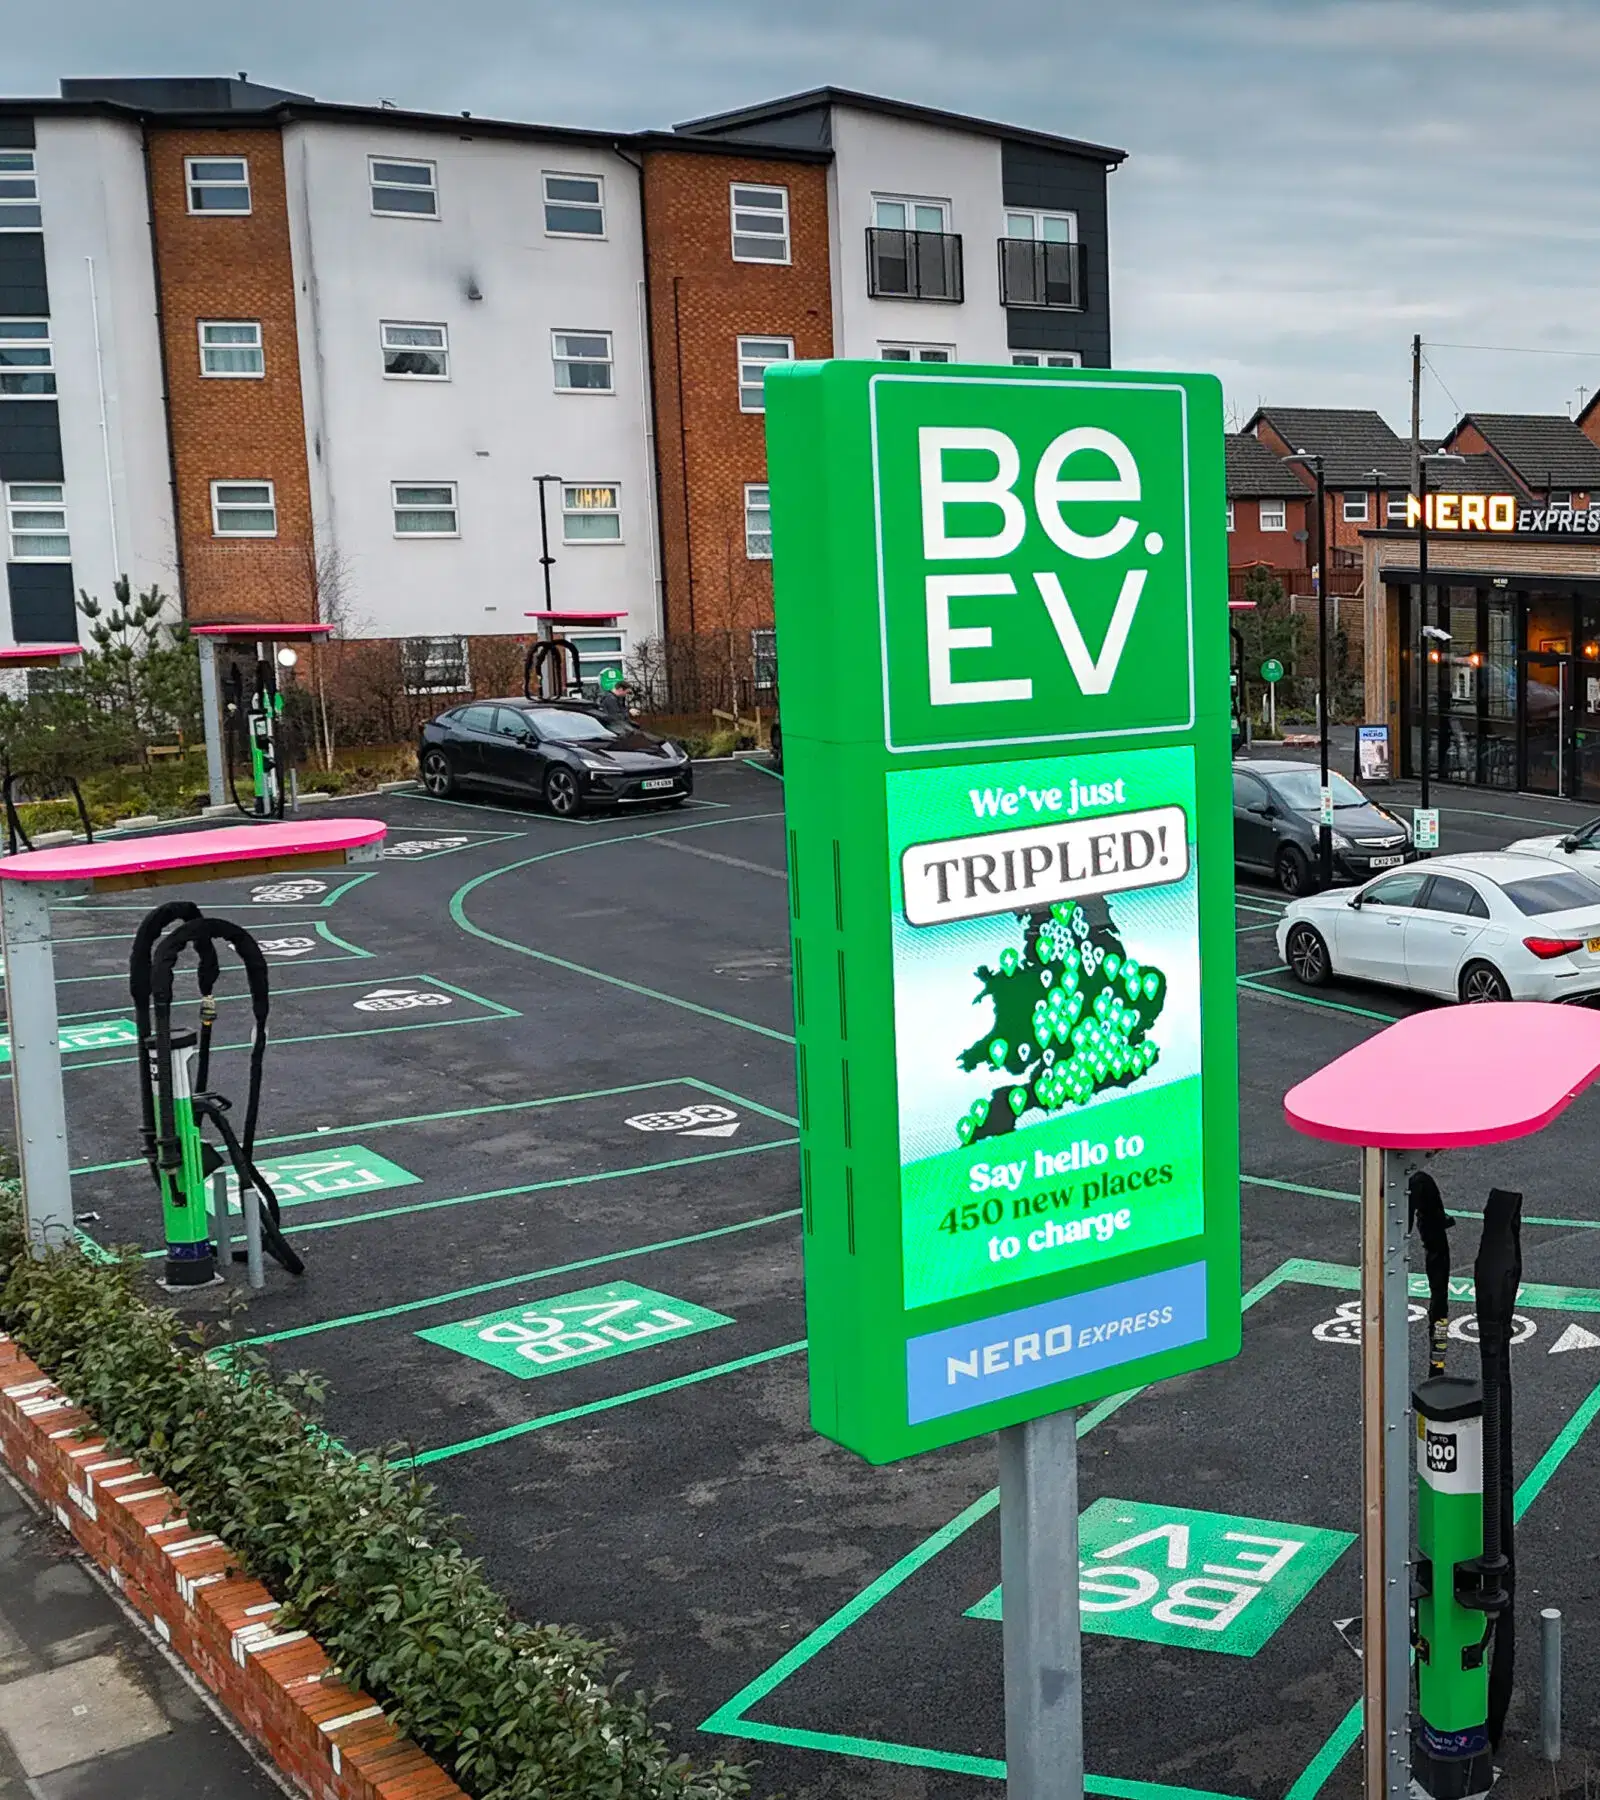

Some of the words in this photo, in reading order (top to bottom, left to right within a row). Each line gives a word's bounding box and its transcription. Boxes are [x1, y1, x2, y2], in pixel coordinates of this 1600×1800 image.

[1407, 493, 1516, 531] NERO
[924, 569, 1148, 706] EV
[969, 785, 1063, 818] We've
[1067, 777, 1126, 816] just
[924, 825, 1169, 905] TRIPLED!
[969, 1158, 1027, 1193] Say
[1034, 1140, 1109, 1180] hello
[1114, 1133, 1145, 1159] to
[938, 1196, 1004, 1236] 450
[1012, 1187, 1074, 1220] new
[1081, 1162, 1174, 1208] places
[988, 1234, 1019, 1263] to
[1027, 1206, 1132, 1254] charge
[946, 1324, 1073, 1385] NERO
[1077, 1305, 1173, 1349] EXPRESS
[1427, 1441, 1455, 1460] 300
[1431, 1461, 1448, 1470] kW
[1092, 1523, 1305, 1582] EV
